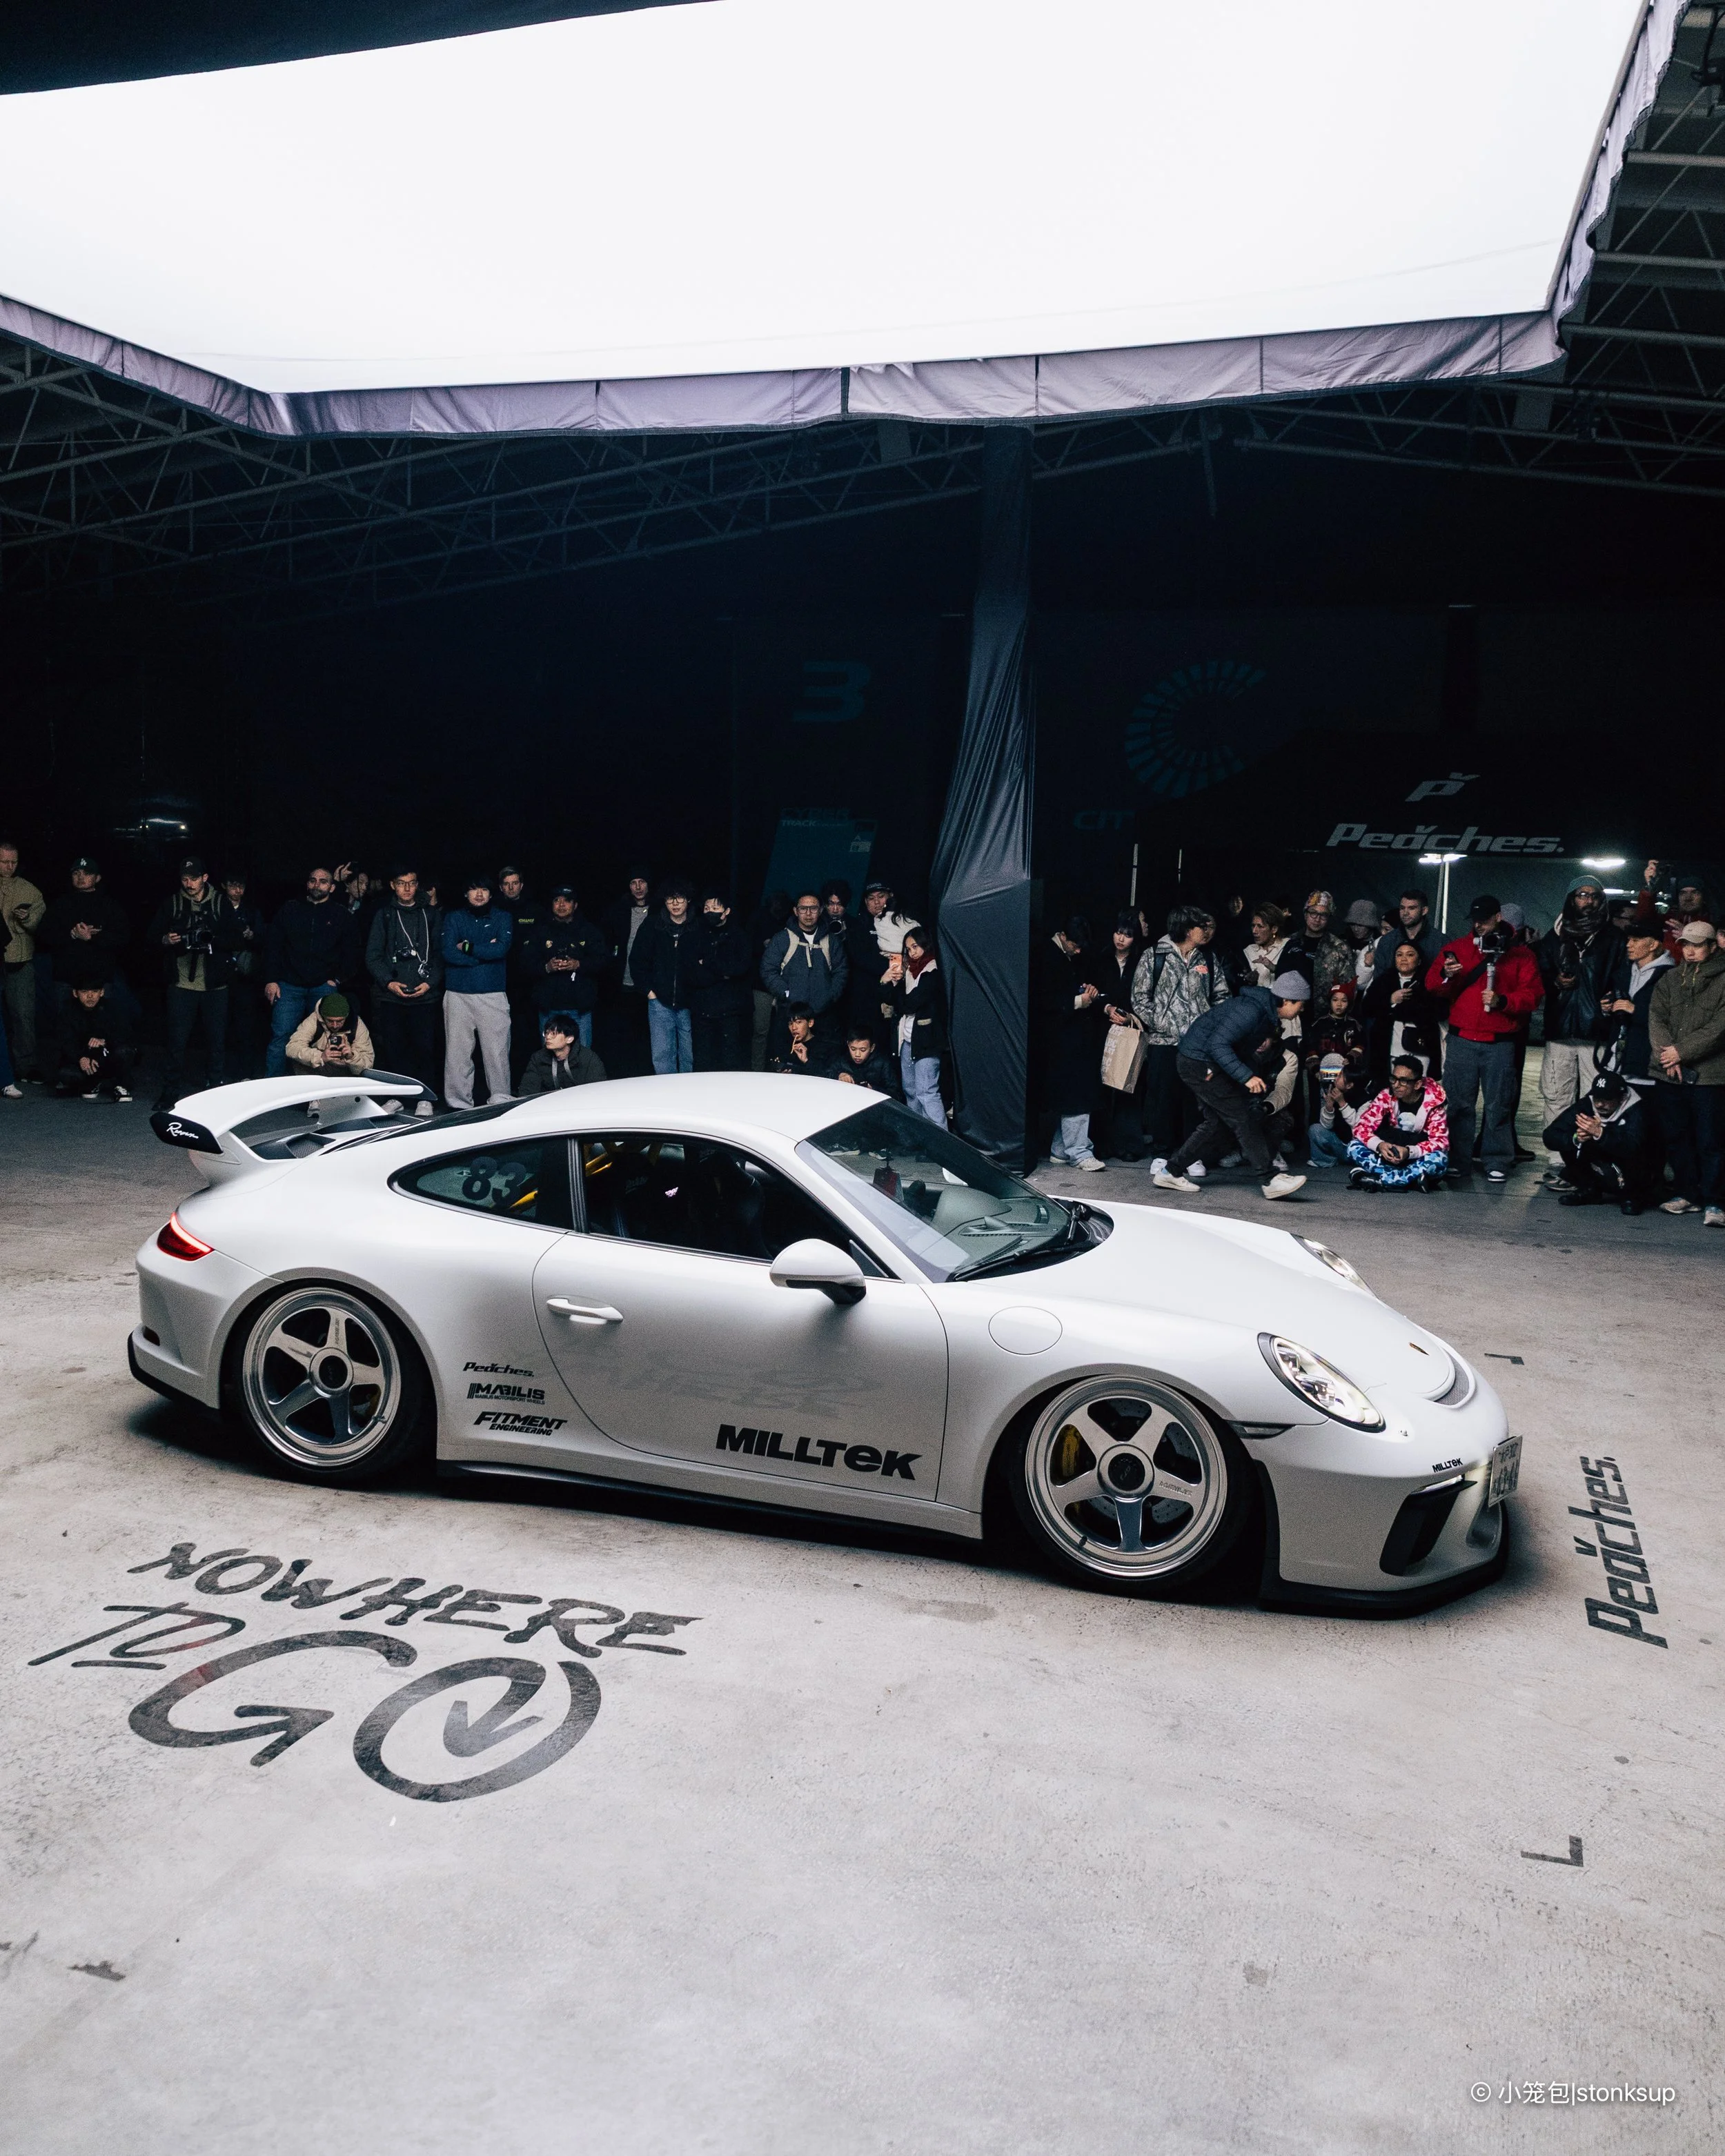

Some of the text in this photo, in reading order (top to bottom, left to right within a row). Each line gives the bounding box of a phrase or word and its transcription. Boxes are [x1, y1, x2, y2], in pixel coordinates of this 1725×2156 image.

[792, 660, 871, 724] 3
[462, 1156, 527, 1207] 83
[467, 1383, 545, 1400] MABILIS
[473, 1411, 568, 1430] FITMENT
[489, 1423, 553, 1436] ENGINEERING
[126, 1541, 703, 1658] NOWHERE
[28, 1601, 246, 1670] TO
[128, 1630, 602, 1803] GO
